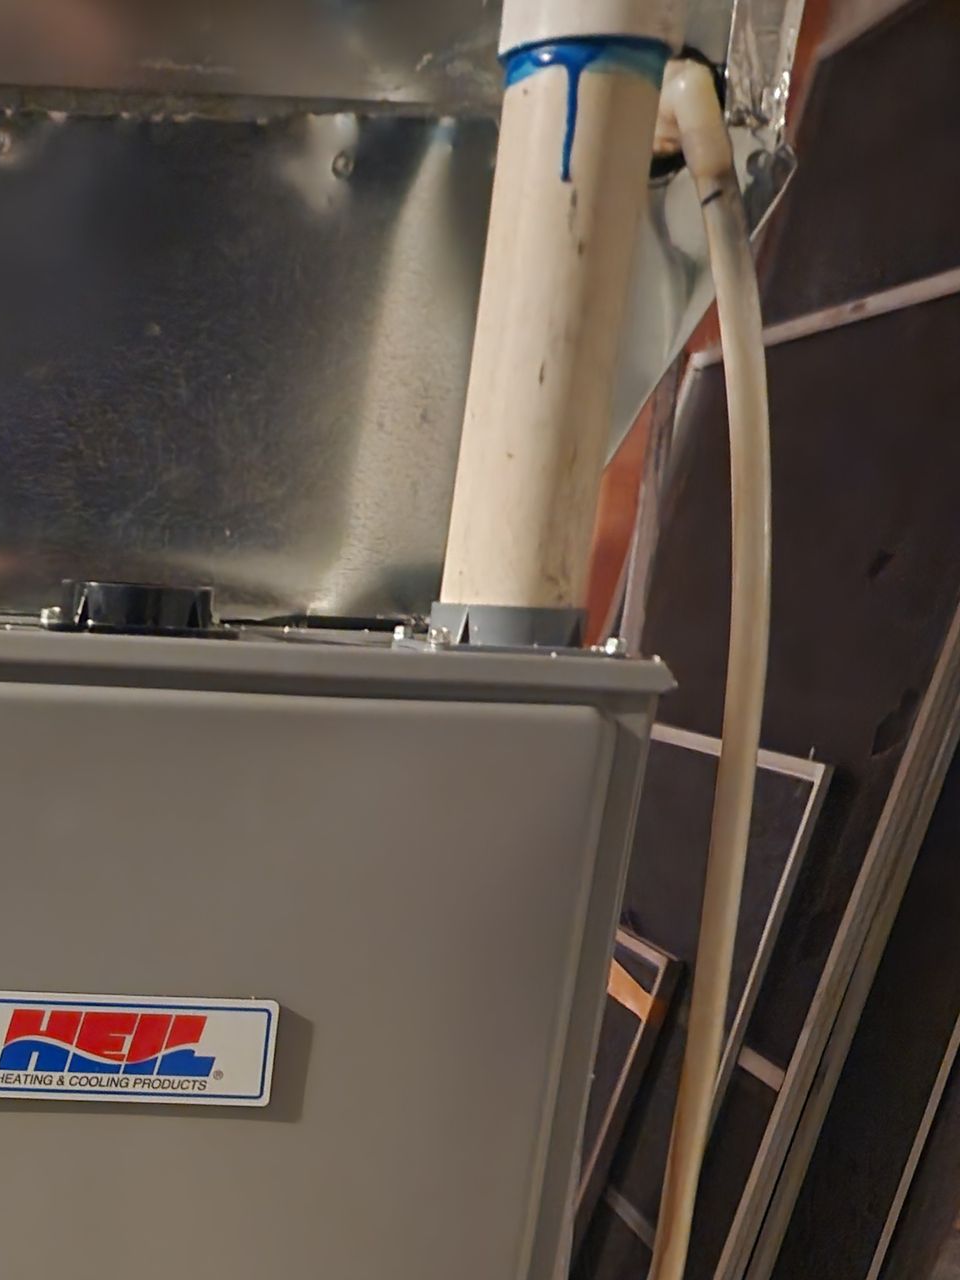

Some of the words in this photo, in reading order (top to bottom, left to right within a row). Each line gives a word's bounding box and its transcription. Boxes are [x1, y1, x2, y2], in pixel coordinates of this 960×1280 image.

[55, 1075, 65, 1086] &
[68, 1075, 130, 1089] COOLING
[132, 1077, 208, 1091] PRODUCTS
